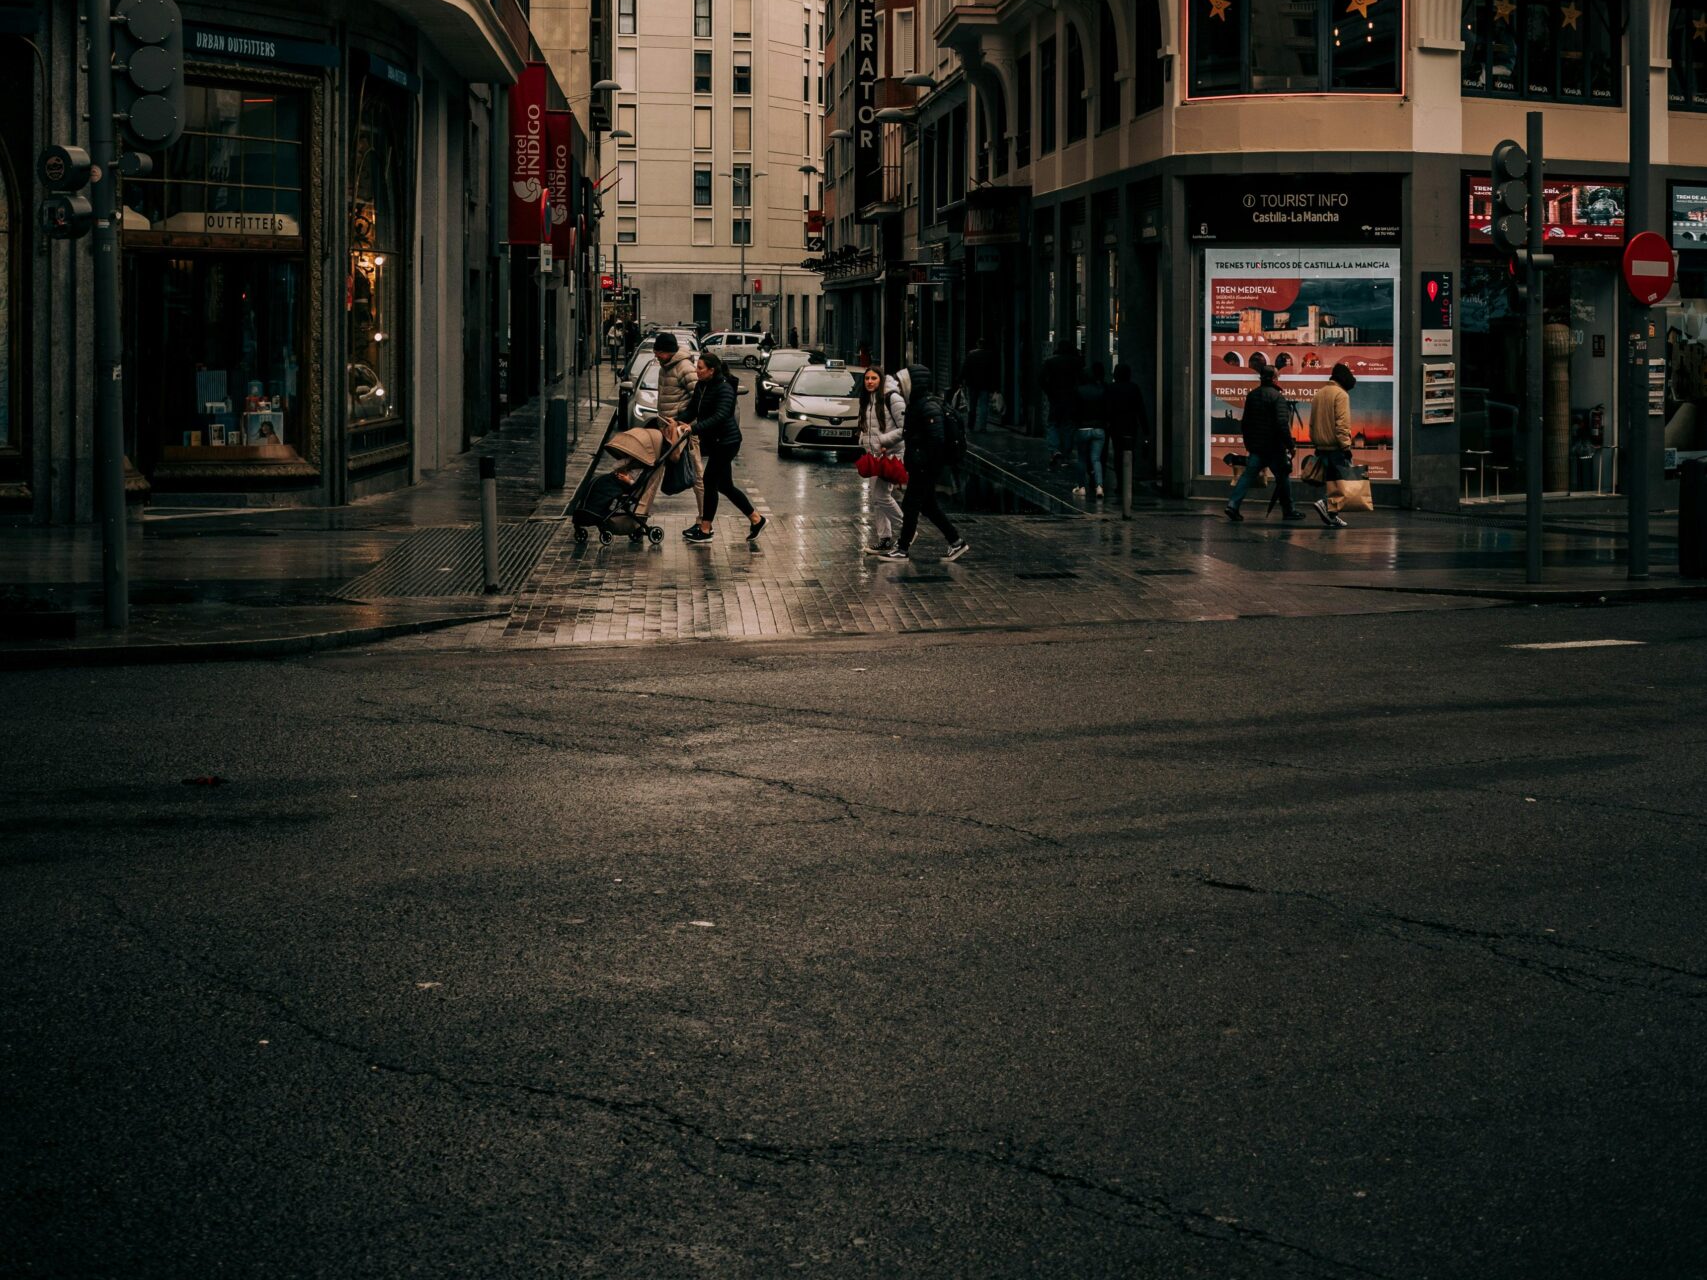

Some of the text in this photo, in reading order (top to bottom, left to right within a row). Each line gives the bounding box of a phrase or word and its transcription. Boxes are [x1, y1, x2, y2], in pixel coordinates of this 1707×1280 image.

[196, 32, 276, 58] URBAN OUTFITTERS
[527, 104, 540, 175] INDIGO
[514, 134, 527, 175] hotel
[556, 144, 567, 203] INDIGO
[1260, 193, 1349, 208] TOURIST INFO
[207, 215, 283, 231] OUTFITTERS
[1303, 211, 1340, 222] Mancha
[1215, 261, 1244, 269] TRENES
[1246, 259, 1291, 269] TURÍSTICOS
[1292, 261, 1302, 269] DE
[1355, 261, 1390, 269] MANCHA
[1215, 286, 1277, 294] TREN MEDIEVAL
[1215, 387, 1236, 395] TREN
